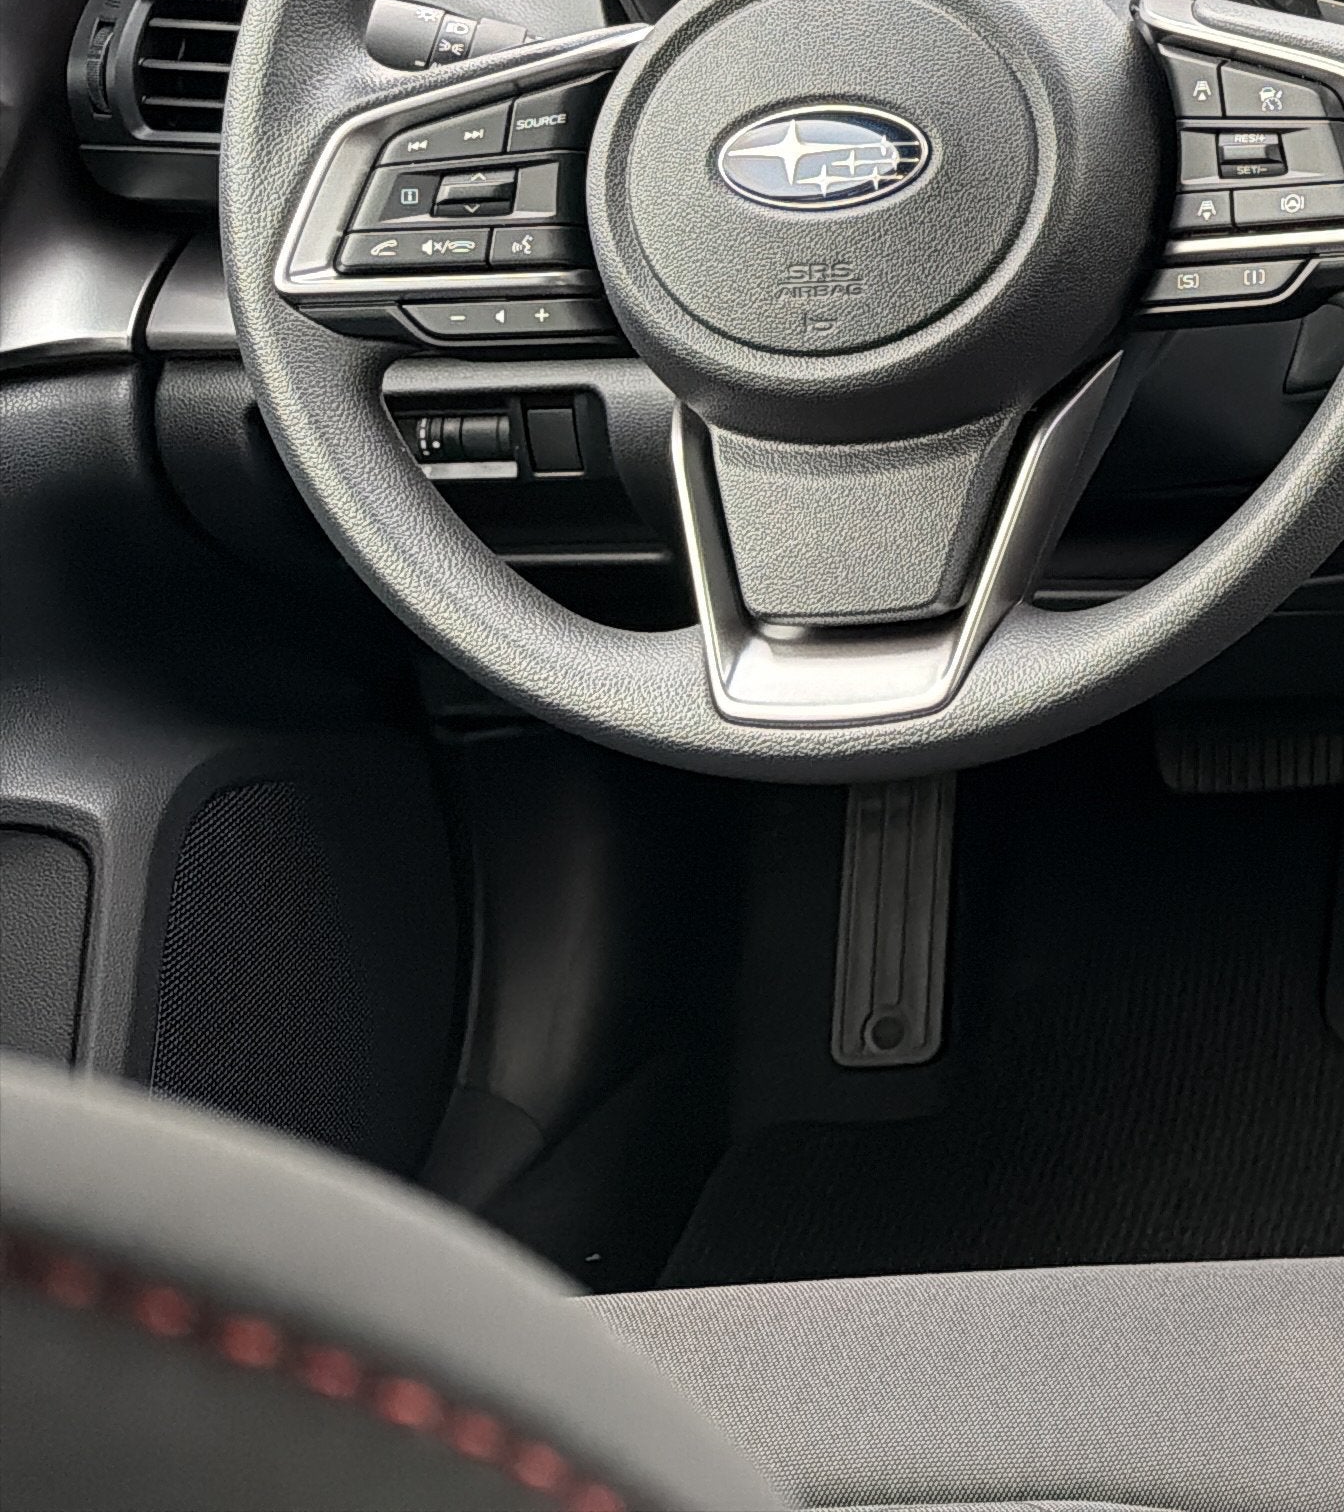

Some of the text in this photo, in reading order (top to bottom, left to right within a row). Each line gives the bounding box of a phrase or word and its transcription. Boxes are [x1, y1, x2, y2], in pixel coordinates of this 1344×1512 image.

[516, 113, 567, 130] SOURCE
[785, 262, 850, 281] SRS
[775, 283, 862, 298] AIRBAG
